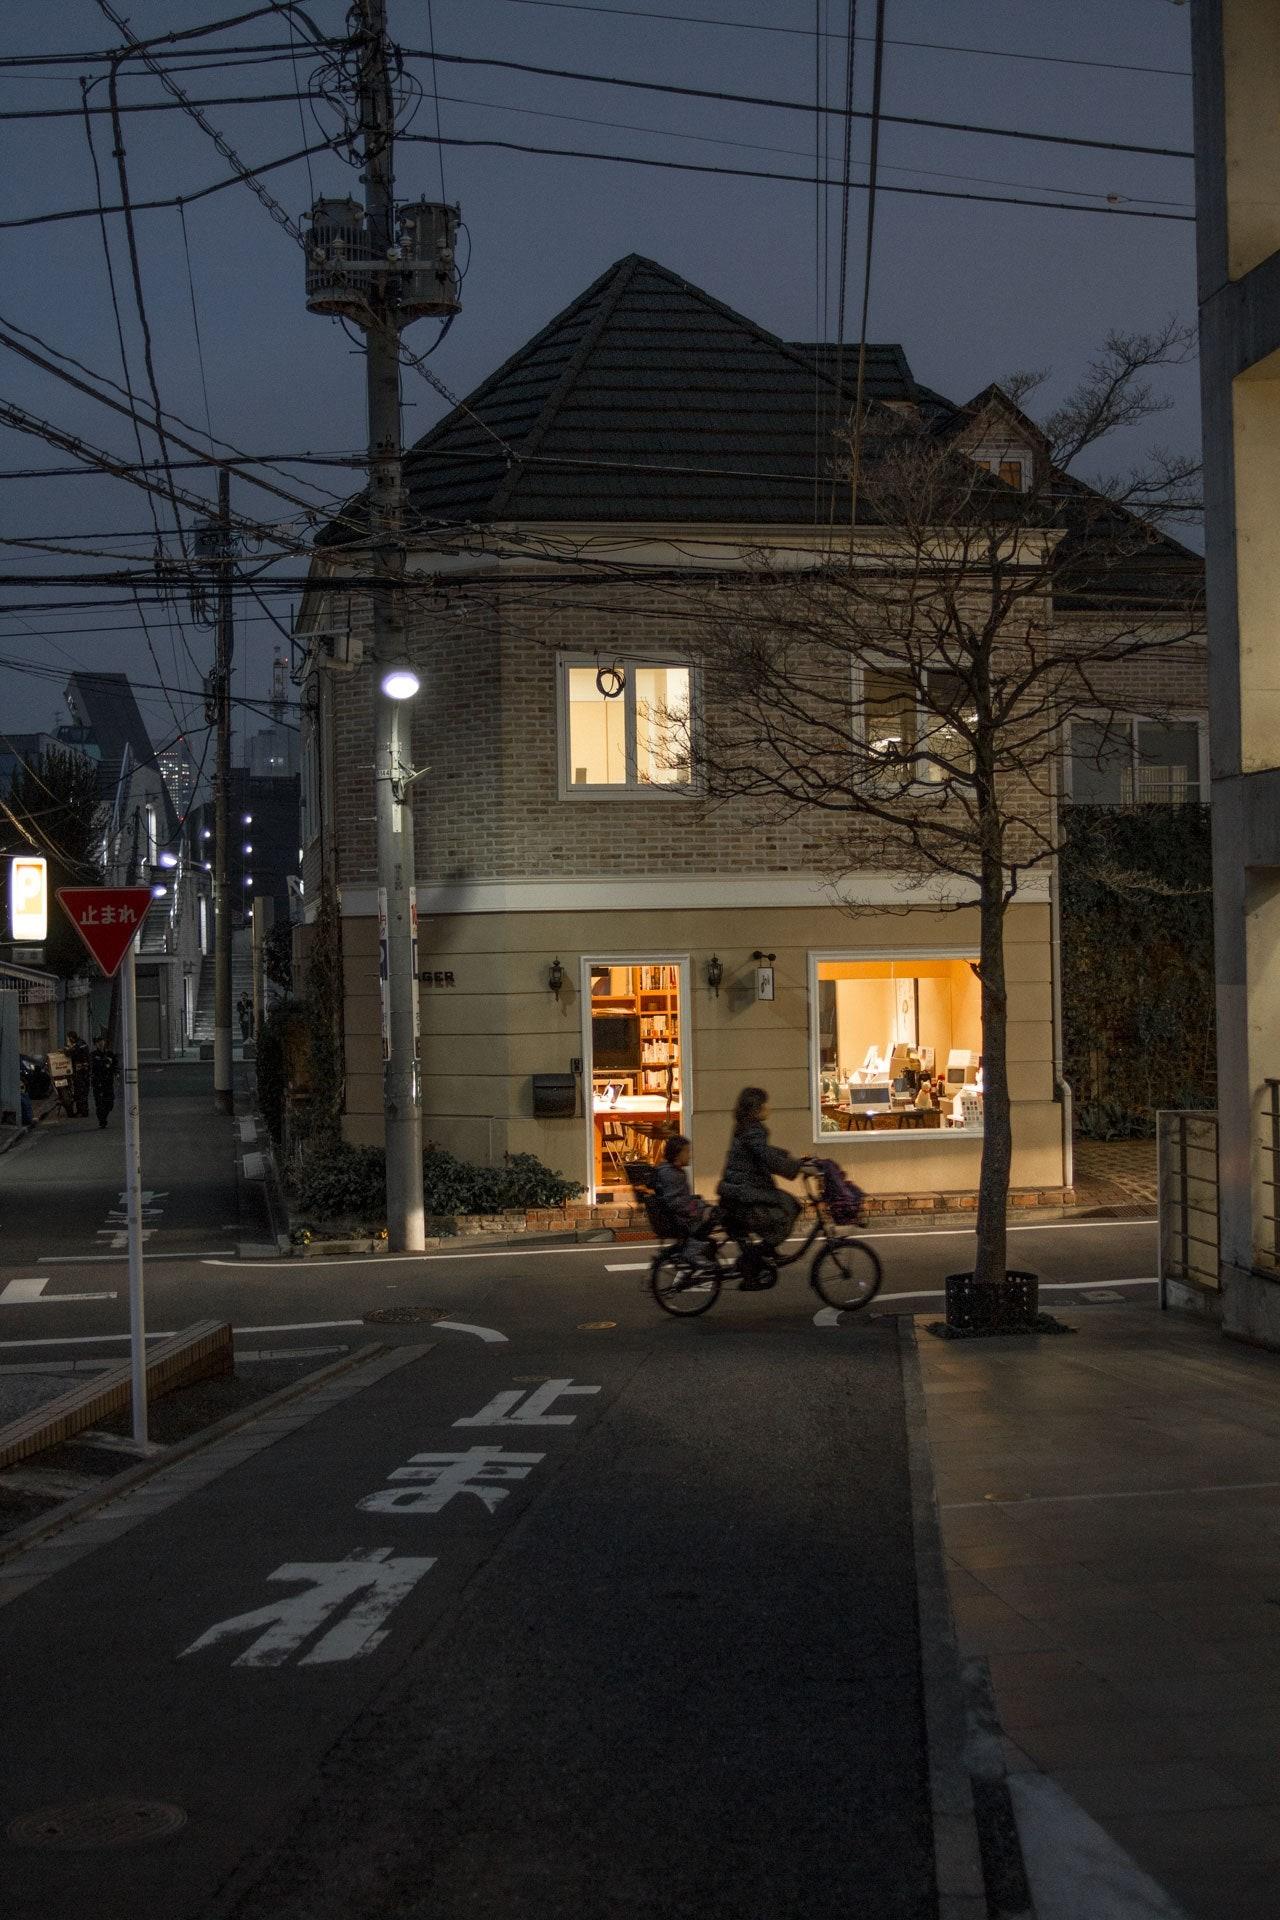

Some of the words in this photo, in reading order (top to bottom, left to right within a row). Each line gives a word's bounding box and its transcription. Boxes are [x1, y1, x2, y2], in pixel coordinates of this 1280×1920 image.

[79, 904, 138, 925] 止まれ
[178, 1379, 602, 1667] 止まれ
